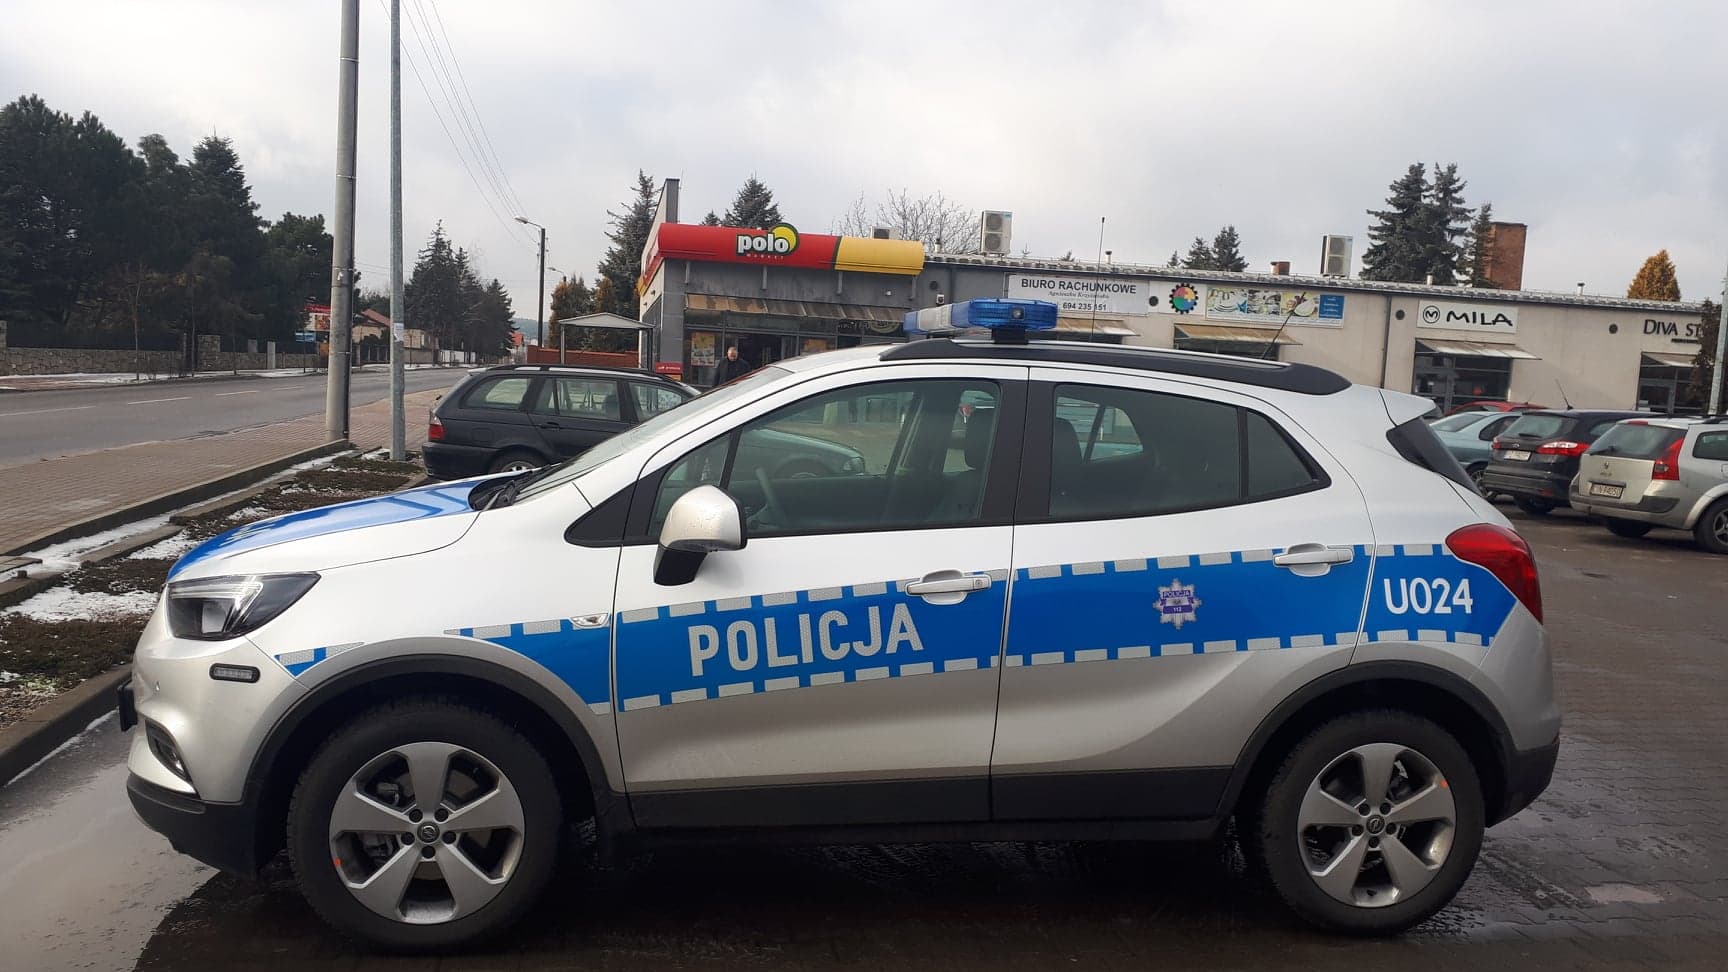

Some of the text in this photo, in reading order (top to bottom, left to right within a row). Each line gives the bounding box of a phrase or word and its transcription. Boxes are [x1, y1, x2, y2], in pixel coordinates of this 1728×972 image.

[737, 233, 789, 254] polo
[1021, 278, 1137, 294] BIURO RACHUNKOWE
[1062, 302, 1076, 310] 694
[1077, 302, 1092, 310] 235
[1446, 310, 1513, 327] MILA
[1643, 319, 1678, 336] DIVA
[1163, 590, 1191, 598] POLICJA
[1384, 577, 1473, 615] U024
[687, 603, 924, 677] POLICJA
